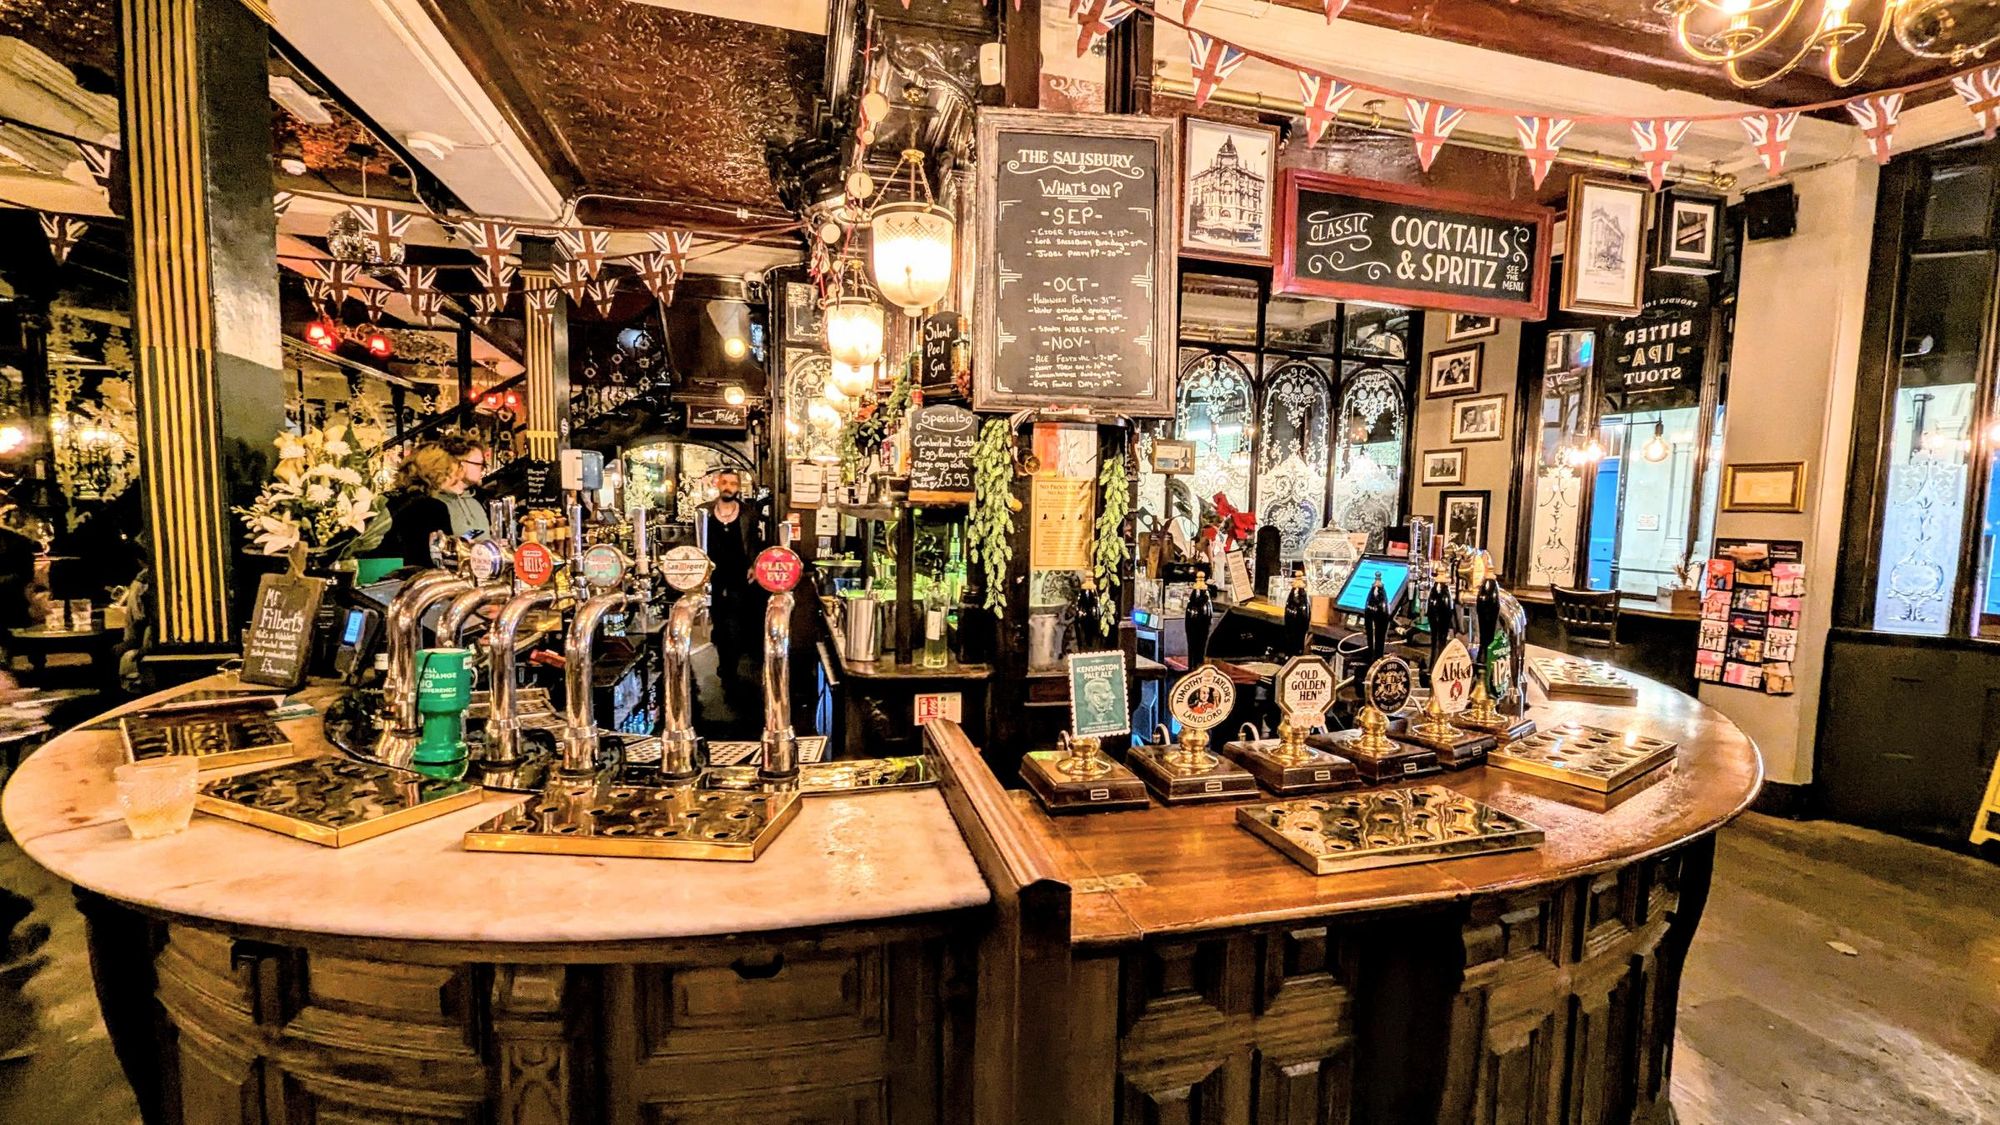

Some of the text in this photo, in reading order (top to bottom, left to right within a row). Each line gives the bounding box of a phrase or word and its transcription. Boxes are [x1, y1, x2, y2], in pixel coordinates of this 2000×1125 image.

[1017, 149, 1135, 169] THE SALISBURY
[1310, 216, 1369, 242] CLASSIC
[1391, 215, 1509, 259] COCKTAILS
[1396, 250, 1498, 289] & SPRITZ
[1506, 265, 1520, 276] SEE
[1506, 273, 1519, 282] THE
[1502, 280, 1525, 292] MENU
[925, 321, 953, 342] Silent
[927, 341, 945, 358] Pool
[930, 360, 947, 378] Gin
[921, 411, 967, 427] Specials
[914, 460, 934, 471] range
[937, 471, 970, 489] £5.95
[1076, 663, 1120, 673] KENSINGTON
[1084, 671, 1099, 680] PALE
[1176, 675, 1232, 704] TIMOTHY TAYLOR'S
[1291, 680, 1327, 691] GOLDEN
[1183, 708, 1223, 724] LANDLORD
